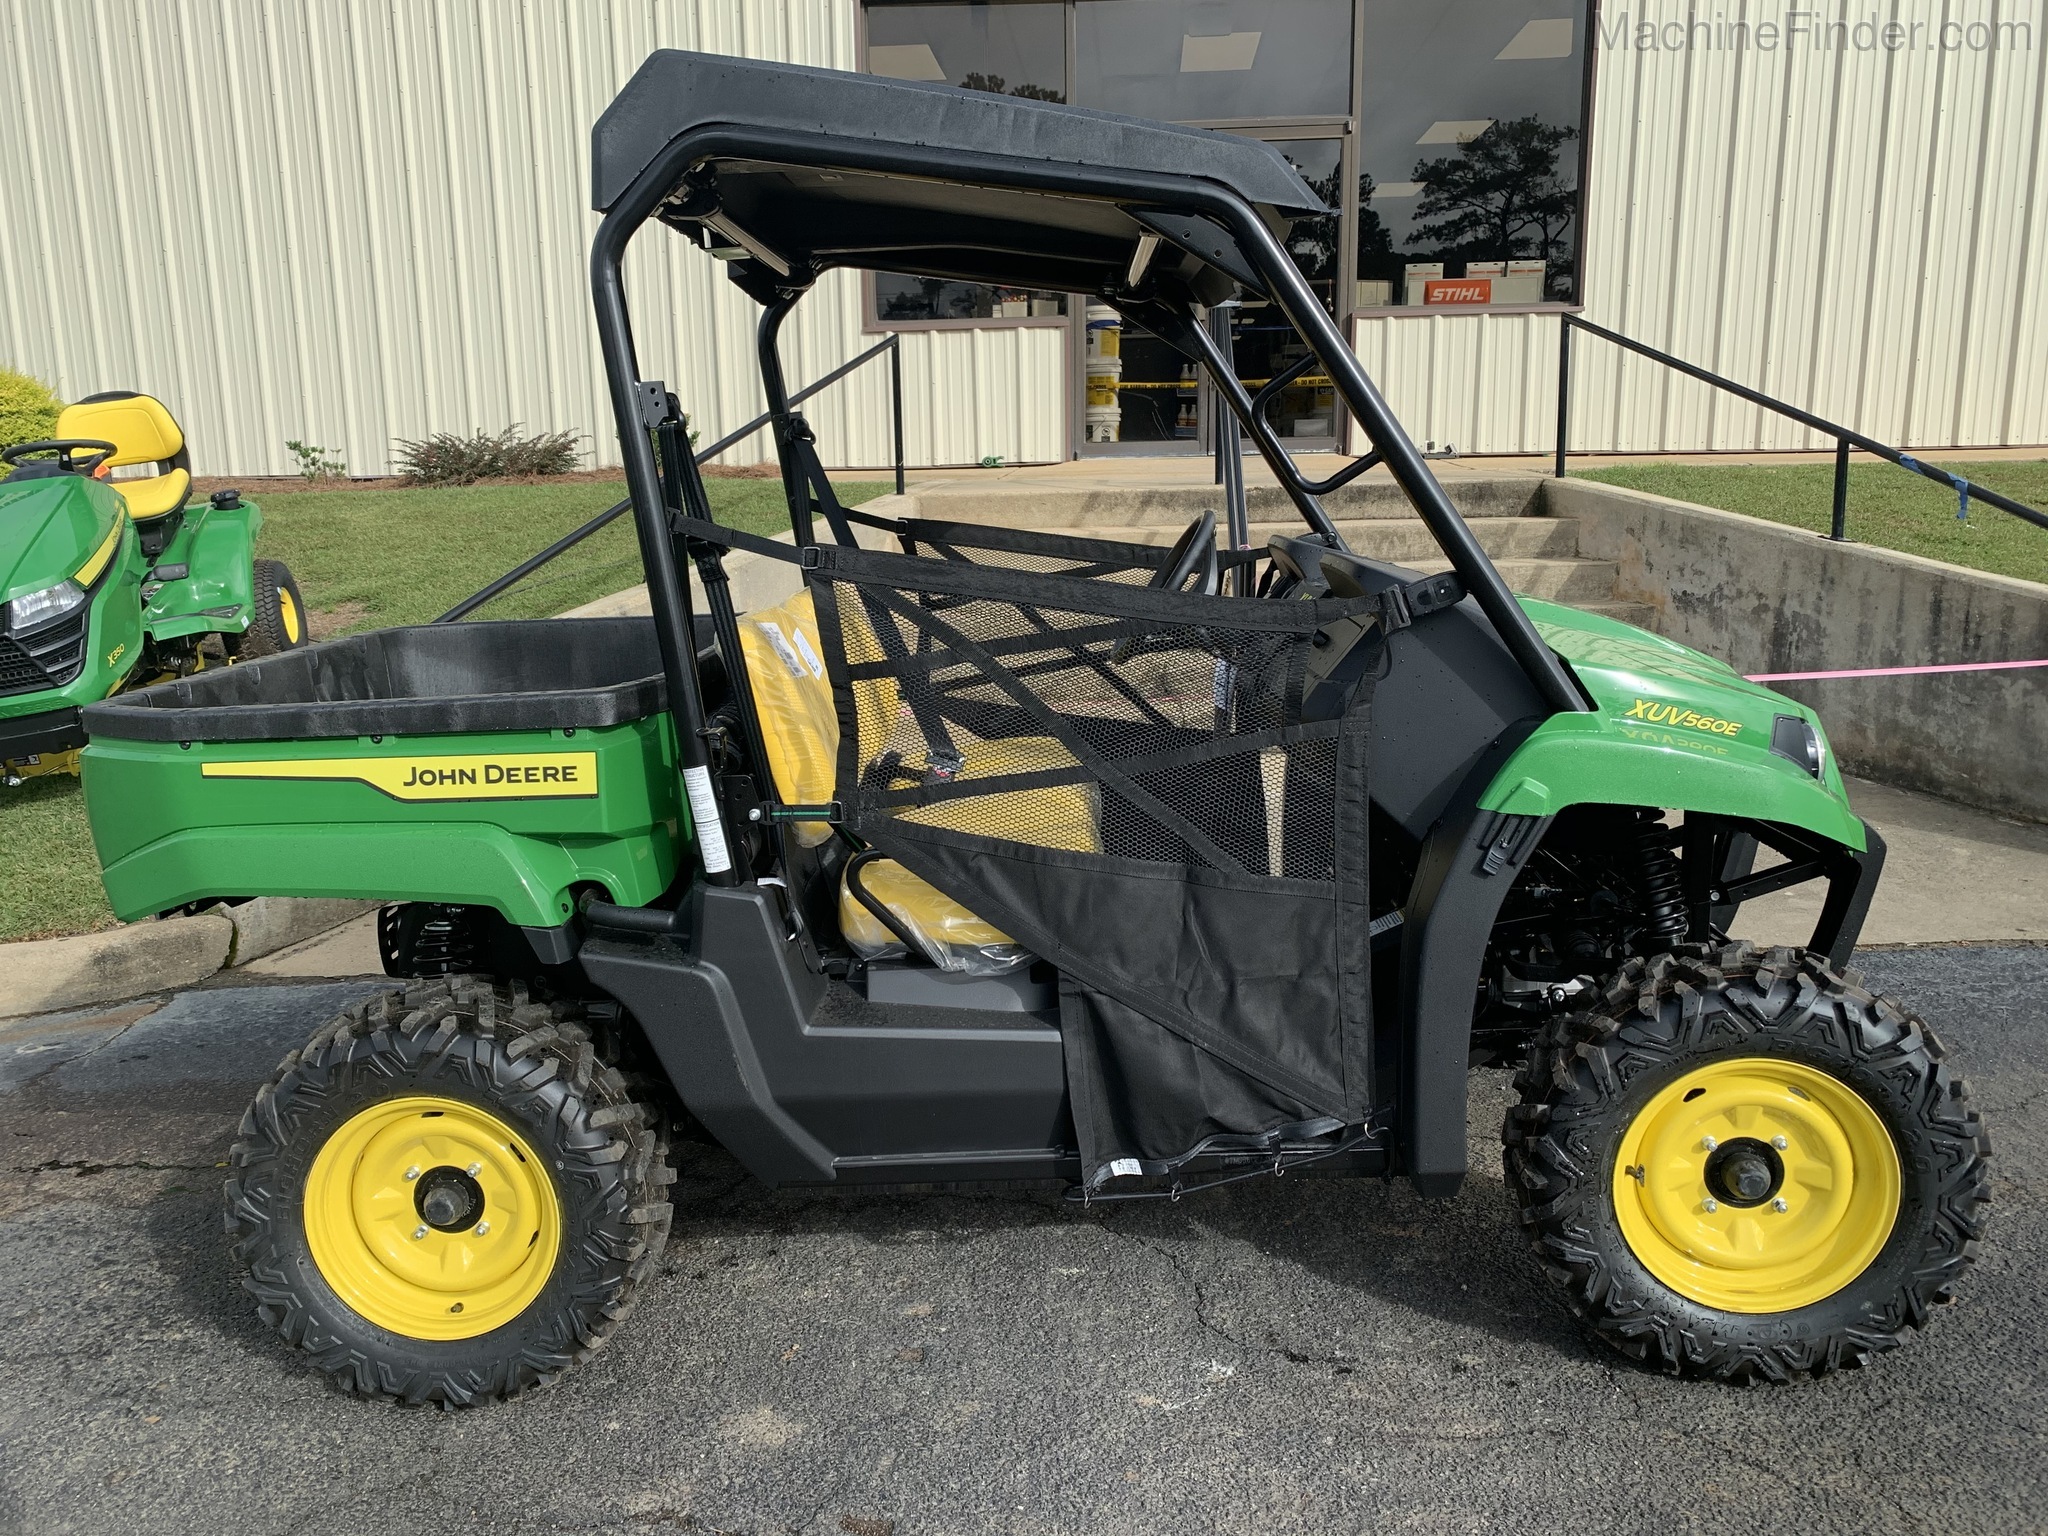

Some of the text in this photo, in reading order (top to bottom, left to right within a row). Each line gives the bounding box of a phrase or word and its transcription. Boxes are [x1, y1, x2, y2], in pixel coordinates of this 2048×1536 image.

[1430, 287, 1484, 302] STIHL
[107, 642, 125, 668] X350
[1624, 698, 1743, 737] XUV560E
[403, 764, 578, 787] JOHN DEERE
